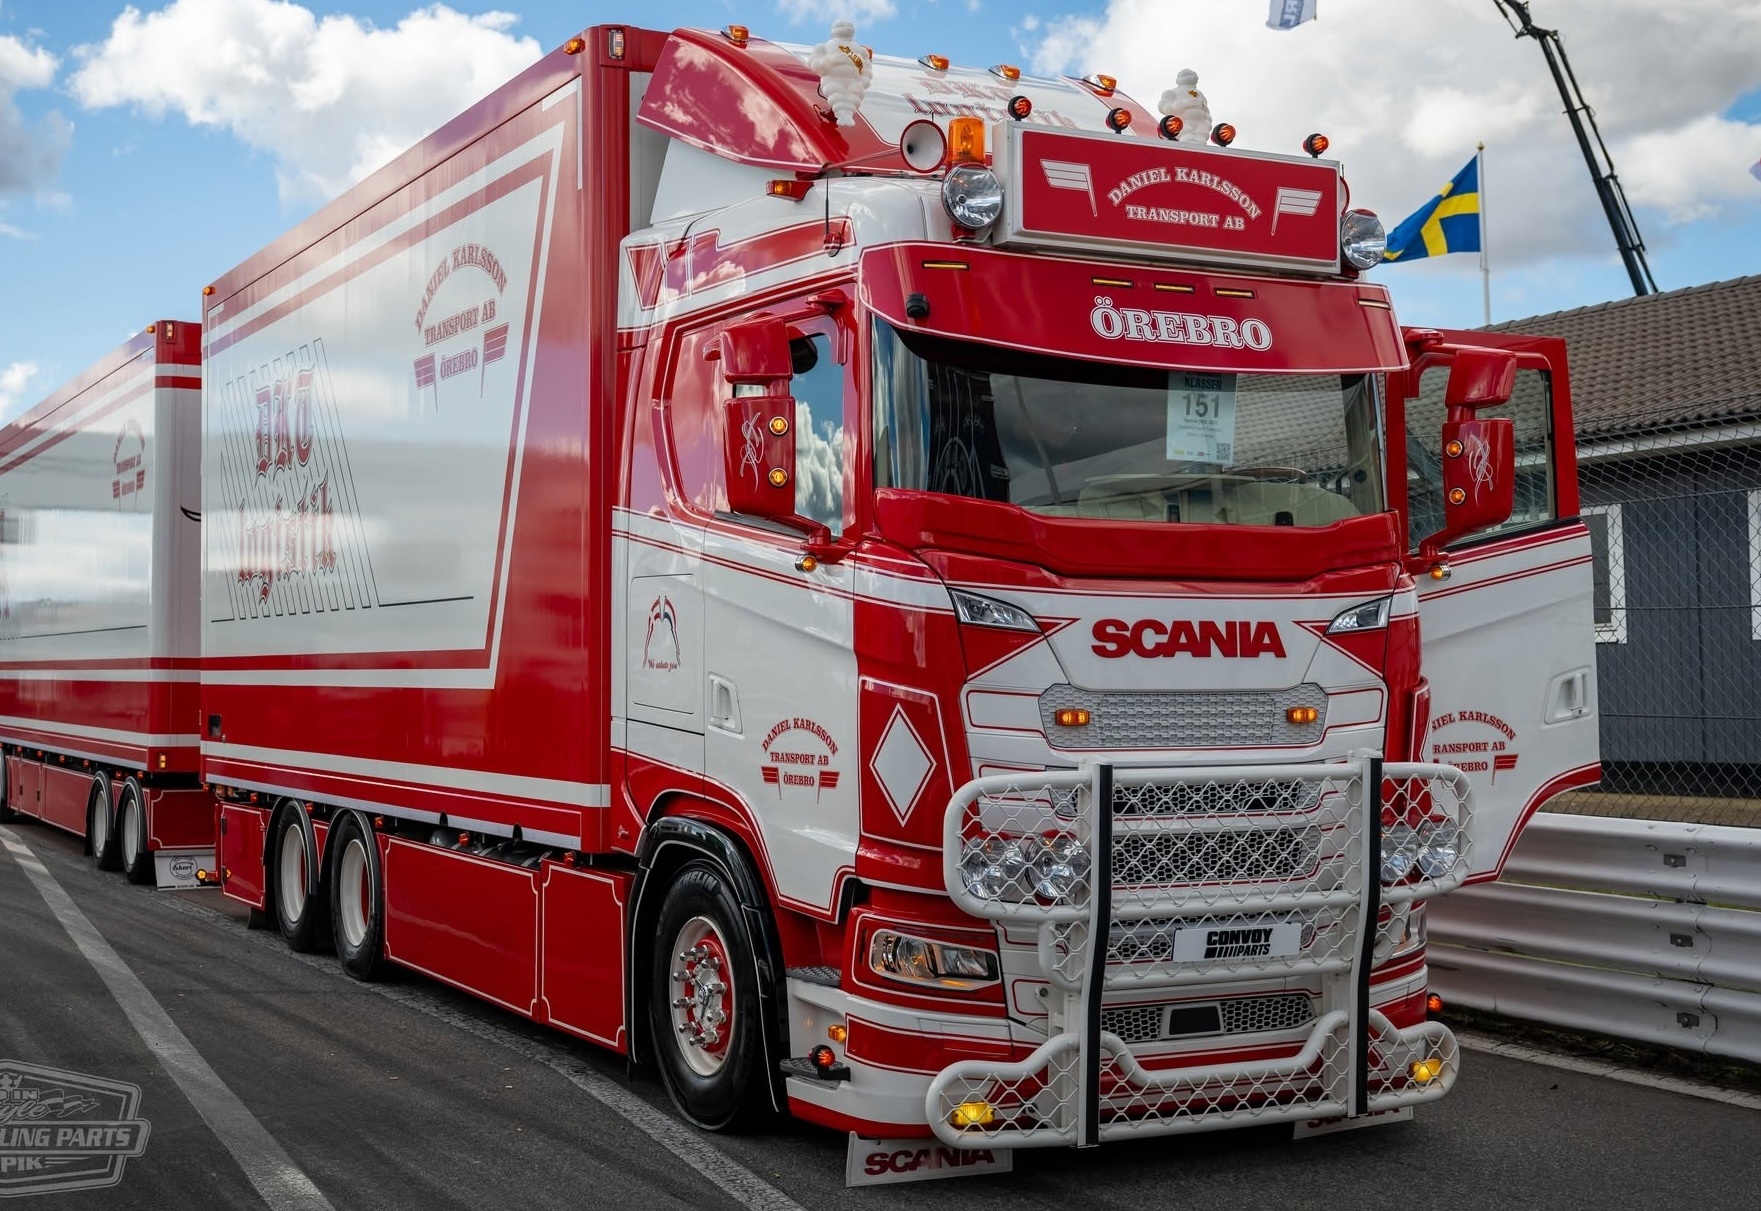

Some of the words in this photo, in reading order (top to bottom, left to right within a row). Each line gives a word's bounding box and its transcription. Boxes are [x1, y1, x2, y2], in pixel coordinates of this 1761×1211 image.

[1107, 167, 1171, 206] DANIEL
[1175, 166, 1262, 221] KARLSSON
[1126, 204, 1219, 228] TRANSPORT
[1223, 216, 1245, 230] AB
[415, 256, 450, 335] DANIEL
[452, 244, 508, 297] KARLSSON
[424, 305, 479, 347] TRANSPORT
[481, 299, 496, 324] AB
[1090, 296, 1272, 351] ÖREBRO
[440, 347, 478, 380] ÖREBRO
[1183, 393, 1219, 418] 151
[1091, 619, 1287, 658] SCANIA
[762, 719, 791, 753] DANIEL
[793, 717, 838, 756] KARLSSON
[1432, 712, 1455, 732] NIEL
[1458, 710, 1516, 741] KARLSSON
[770, 752, 815, 765] TRANSPORT
[818, 755, 829, 766] AB
[1433, 742, 1489, 754] RANSPORT
[1491, 741, 1505, 751] AB
[783, 771, 815, 787] ÖREBRO
[1447, 761, 1488, 773] REBRO
[1206, 928, 1273, 946] CONVOY
[1236, 944, 1271, 956] PARTS
[864, 1146, 996, 1176] SCANIA
